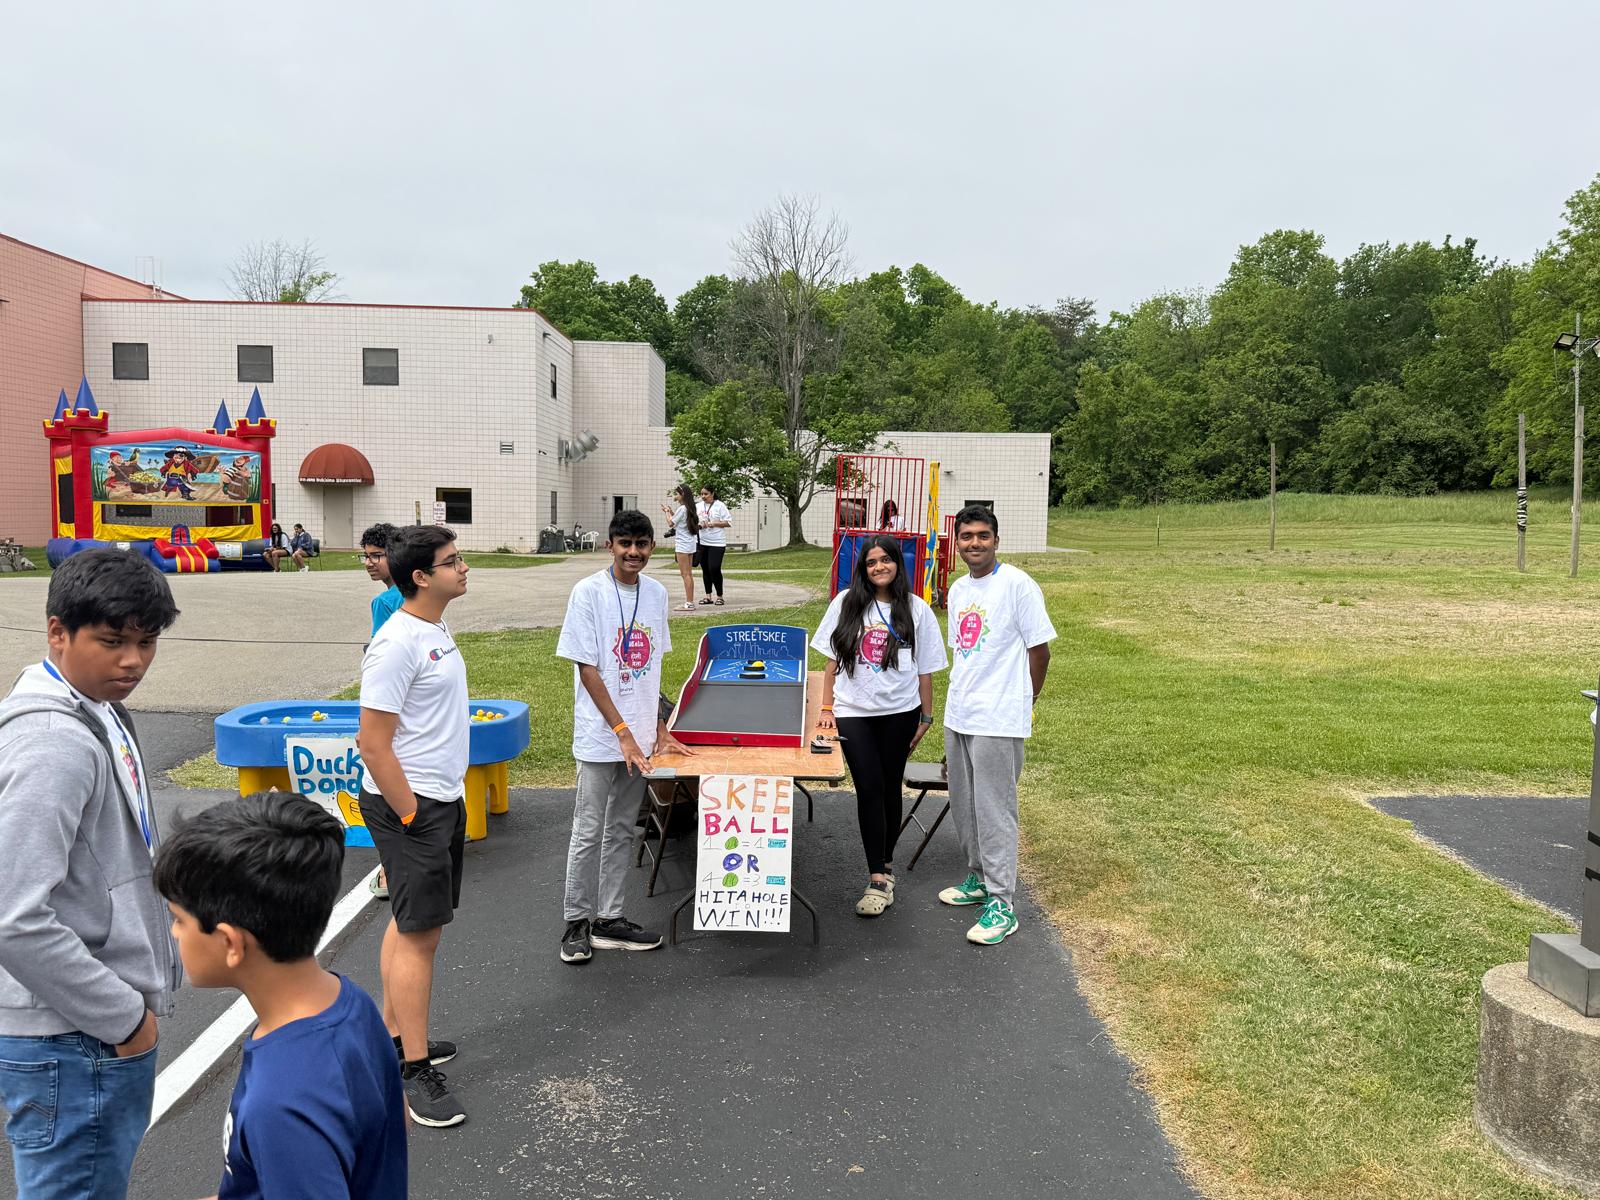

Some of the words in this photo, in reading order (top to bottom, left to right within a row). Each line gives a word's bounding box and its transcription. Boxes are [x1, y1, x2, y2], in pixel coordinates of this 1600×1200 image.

[726, 630, 787, 643] STREETSKEE
[293, 745, 365, 775] Duck
[701, 776, 791, 814] SKEE
[704, 813, 788, 836] BALL
[703, 836, 721, 850] 1
[754, 836, 765, 849] 1
[722, 853, 760, 873] OR
[702, 871, 722, 889] 4
[752, 892, 789, 905] HOLE
[698, 907, 783, 928] WIN!!!
